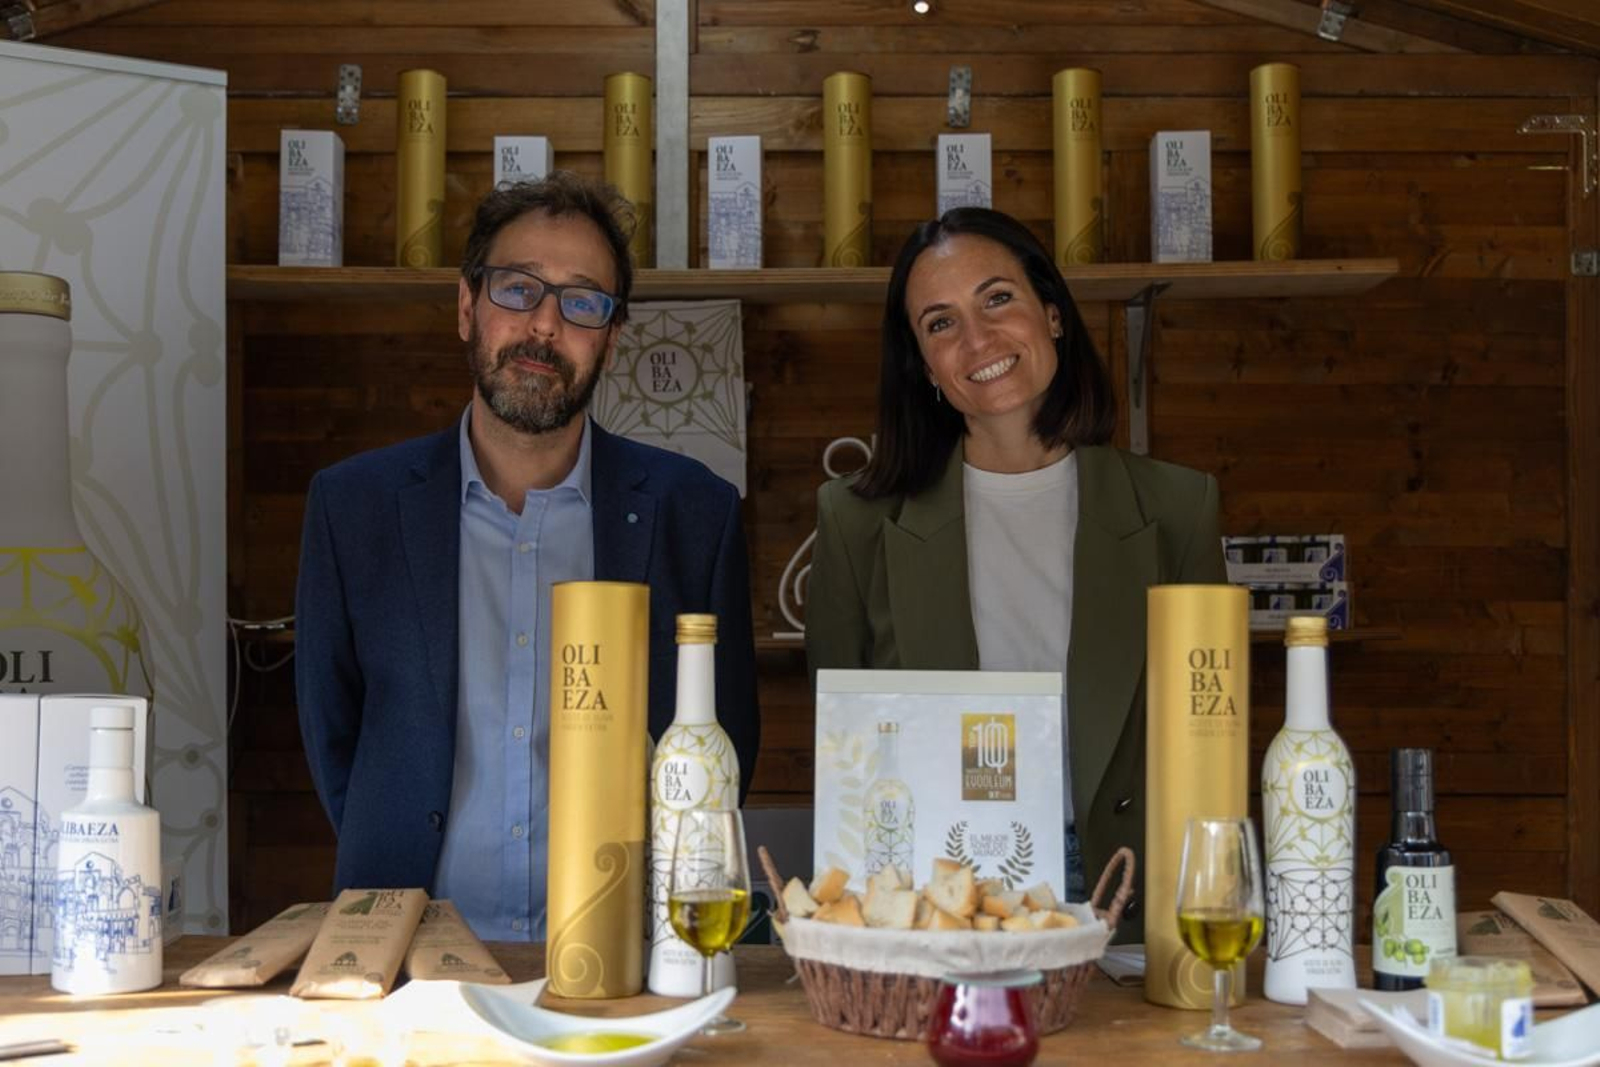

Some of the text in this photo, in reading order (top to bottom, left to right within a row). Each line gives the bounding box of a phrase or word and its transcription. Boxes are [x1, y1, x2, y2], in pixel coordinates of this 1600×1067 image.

[1070, 98, 1091, 109] OLI
[1265, 93, 1287, 104] OLI
[408, 99, 431, 111] OLI
[614, 103, 636, 114] OLI
[837, 102, 860, 114] OLI
[1267, 105, 1283, 115] BA
[409, 111, 426, 121] BA
[616, 114, 631, 125] BA
[840, 114, 856, 125] BA
[1072, 109, 1088, 119] BA
[1072, 120, 1095, 131] EZA
[1267, 115, 1291, 127] EZA
[410, 122, 435, 134] EZA
[616, 126, 639, 137] EZA
[840, 126, 864, 136] EZA
[287, 140, 306, 150] OLI
[501, 146, 519, 155] OLI
[715, 145, 734, 155] OLI
[946, 144, 964, 153] OLI
[1165, 140, 1183, 150] OLI
[288, 158, 308, 167] EZA
[717, 162, 736, 171] EZA
[948, 161, 967, 171] EZA
[1167, 158, 1187, 167] EZA
[650, 352, 676, 365] OLI
[652, 366, 672, 378] BA
[653, 379, 682, 393] EZA
[562, 644, 600, 665] OLI
[1188, 648, 1231, 670] OLI
[0, 650, 54, 683] LI
[563, 666, 591, 688] BA
[1191, 671, 1223, 692] BA
[563, 689, 608, 710] EZA
[1191, 694, 1237, 716] EZA
[664, 762, 687, 775] OLI
[665, 775, 682, 787] BA
[1303, 769, 1329, 782] OLI
[665, 788, 692, 801] EZA
[1304, 783, 1324, 796] BA
[1305, 797, 1334, 810] EZA
[1406, 874, 1437, 889] OLI
[1408, 890, 1431, 904] BA
[1408, 905, 1443, 920] EZA
